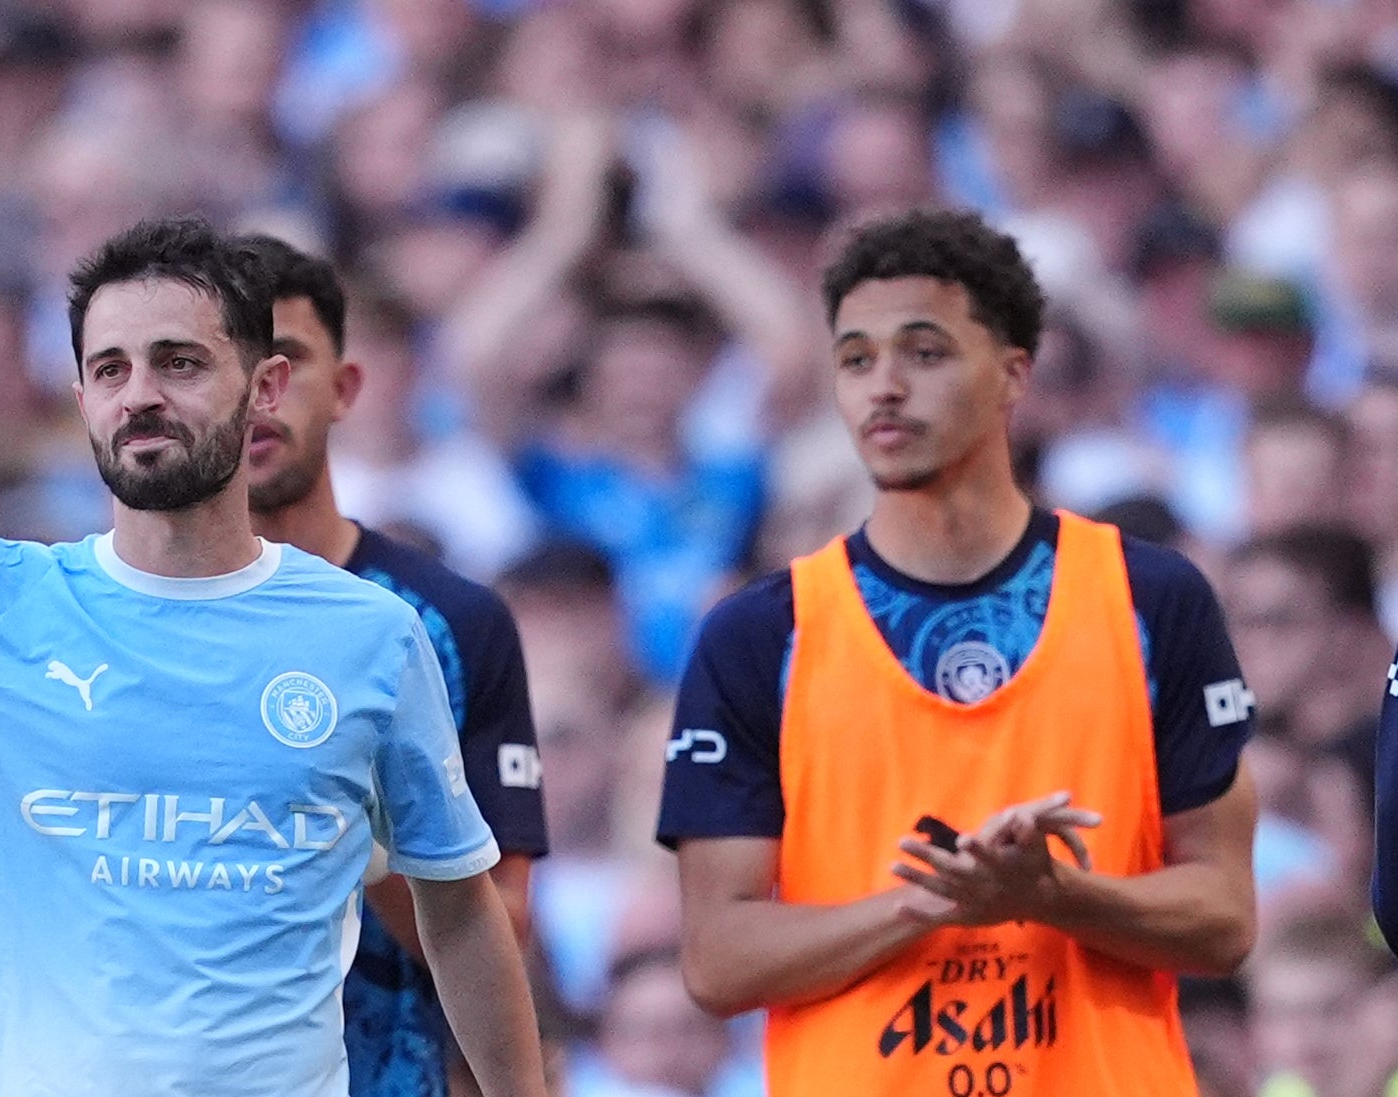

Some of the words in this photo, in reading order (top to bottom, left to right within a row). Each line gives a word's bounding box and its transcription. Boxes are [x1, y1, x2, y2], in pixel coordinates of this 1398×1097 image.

[20, 789, 351, 850] ETIHAD
[90, 855, 285, 895] AIRWAYS
[879, 974, 1058, 1058] Asahi
